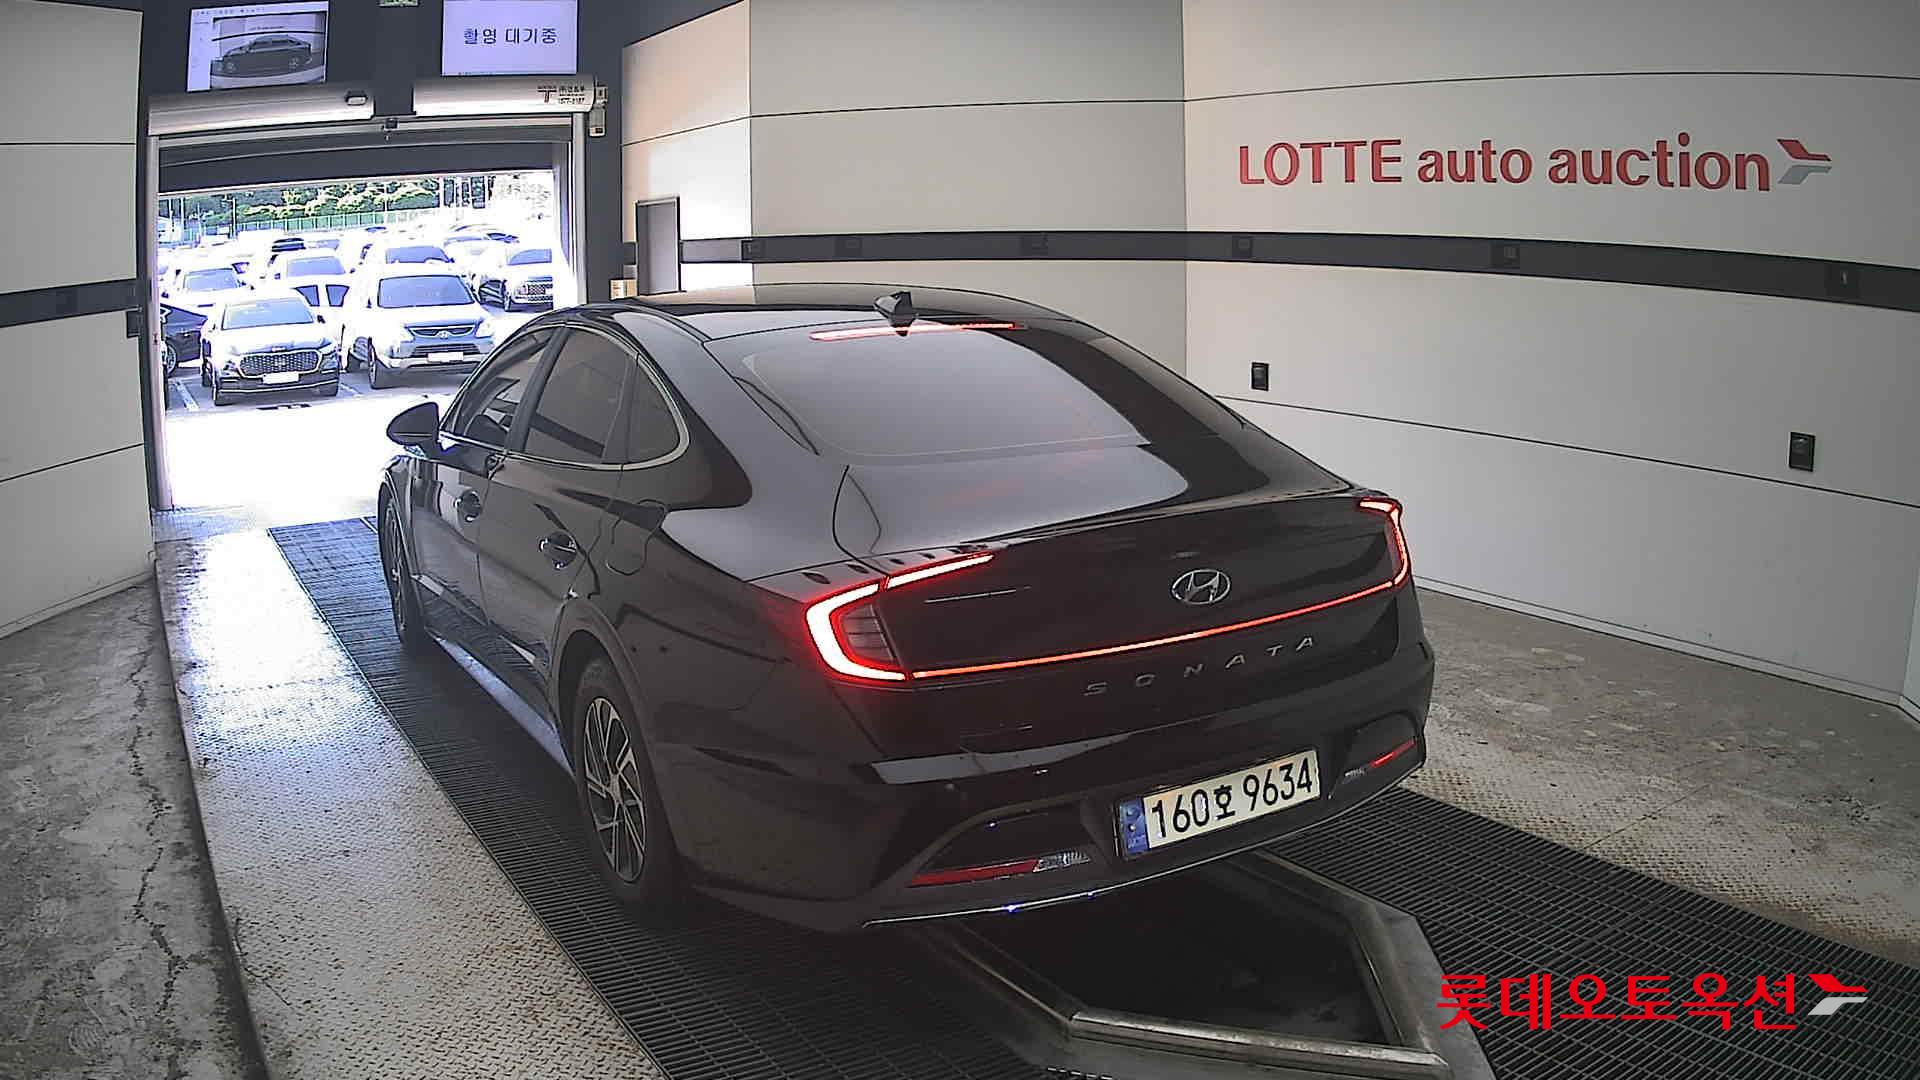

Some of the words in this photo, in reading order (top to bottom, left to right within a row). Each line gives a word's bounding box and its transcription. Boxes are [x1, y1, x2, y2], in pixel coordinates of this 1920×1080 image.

[505, 27, 557, 45] 대기중
[1239, 139, 1402, 185] LOTTE
[1416, 140, 1533, 184] auto
[1547, 132, 1771, 192] auction
[1084, 637, 1314, 696] SONATA
[1151, 784, 1236, 838] 160호
[1243, 757, 1313, 811] 9634
